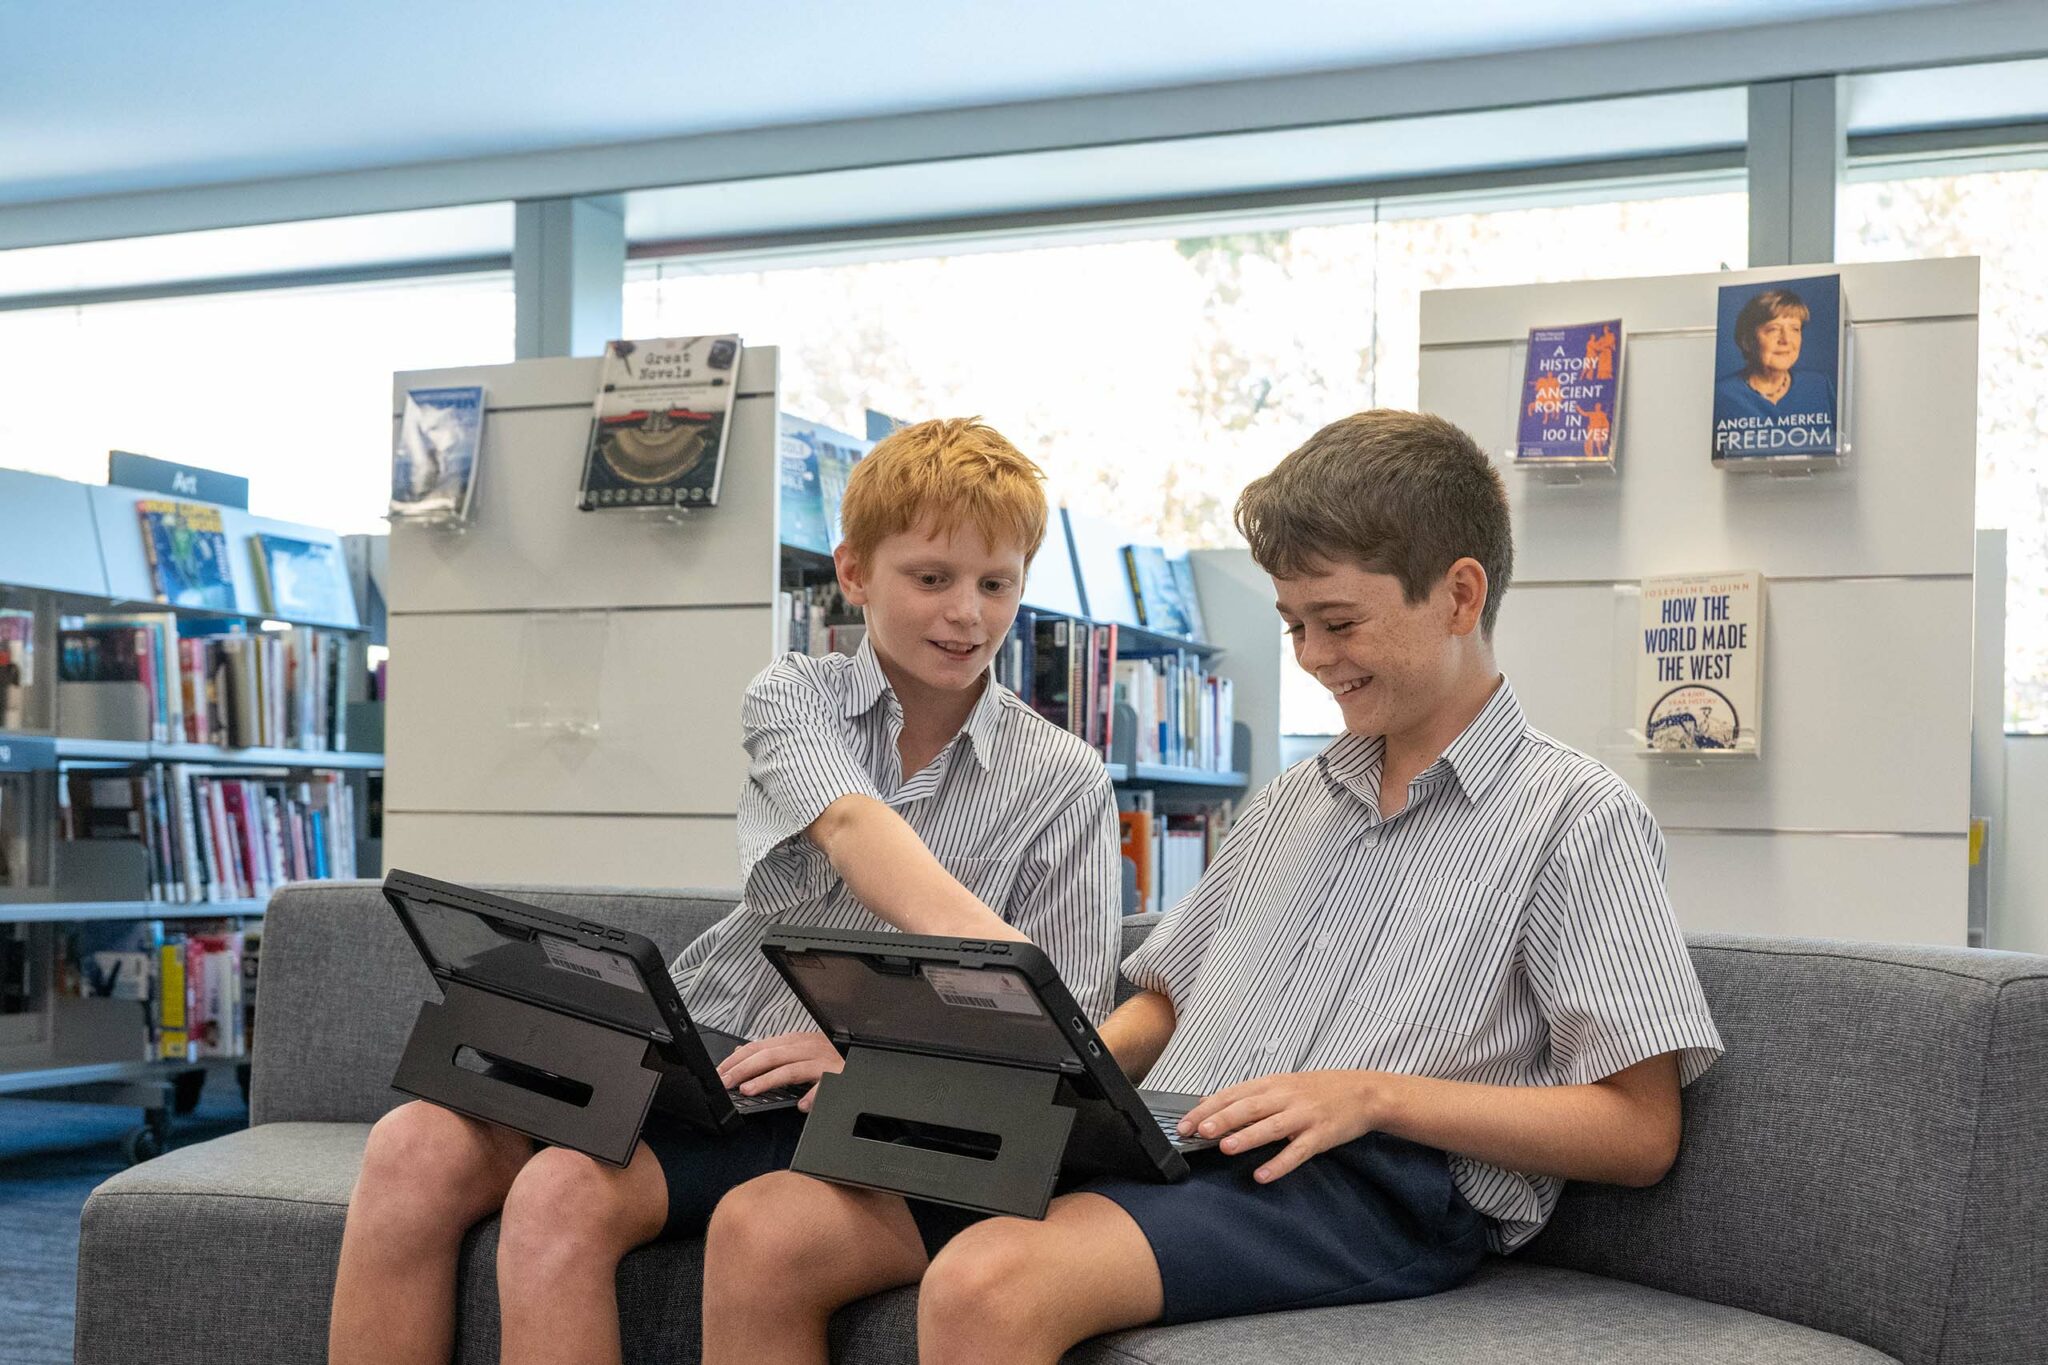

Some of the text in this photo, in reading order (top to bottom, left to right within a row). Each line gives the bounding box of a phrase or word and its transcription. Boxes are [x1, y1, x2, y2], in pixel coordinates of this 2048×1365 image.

[645, 352, 690, 365] Great
[1553, 345, 1565, 357] A
[1540, 356, 1599, 371] HISTORY
[640, 366, 691, 380] Novels
[1557, 372, 1578, 385] OF
[1536, 384, 1603, 399] ANCIENT
[1535, 400, 1577, 413] ROME
[1565, 414, 1582, 427] IN
[1717, 412, 1832, 430] ANGELA MERKEL
[1543, 428, 1609, 441] 100 LIVES
[1716, 426, 1831, 451] FREEDOM
[172, 470, 197, 495] Art
[1645, 583, 1749, 598] JOSEPHINE QUINN
[1662, 595, 1730, 624] HOW THE
[1645, 623, 1747, 654] WORLD MADE
[1657, 653, 1732, 681] THE WEST
